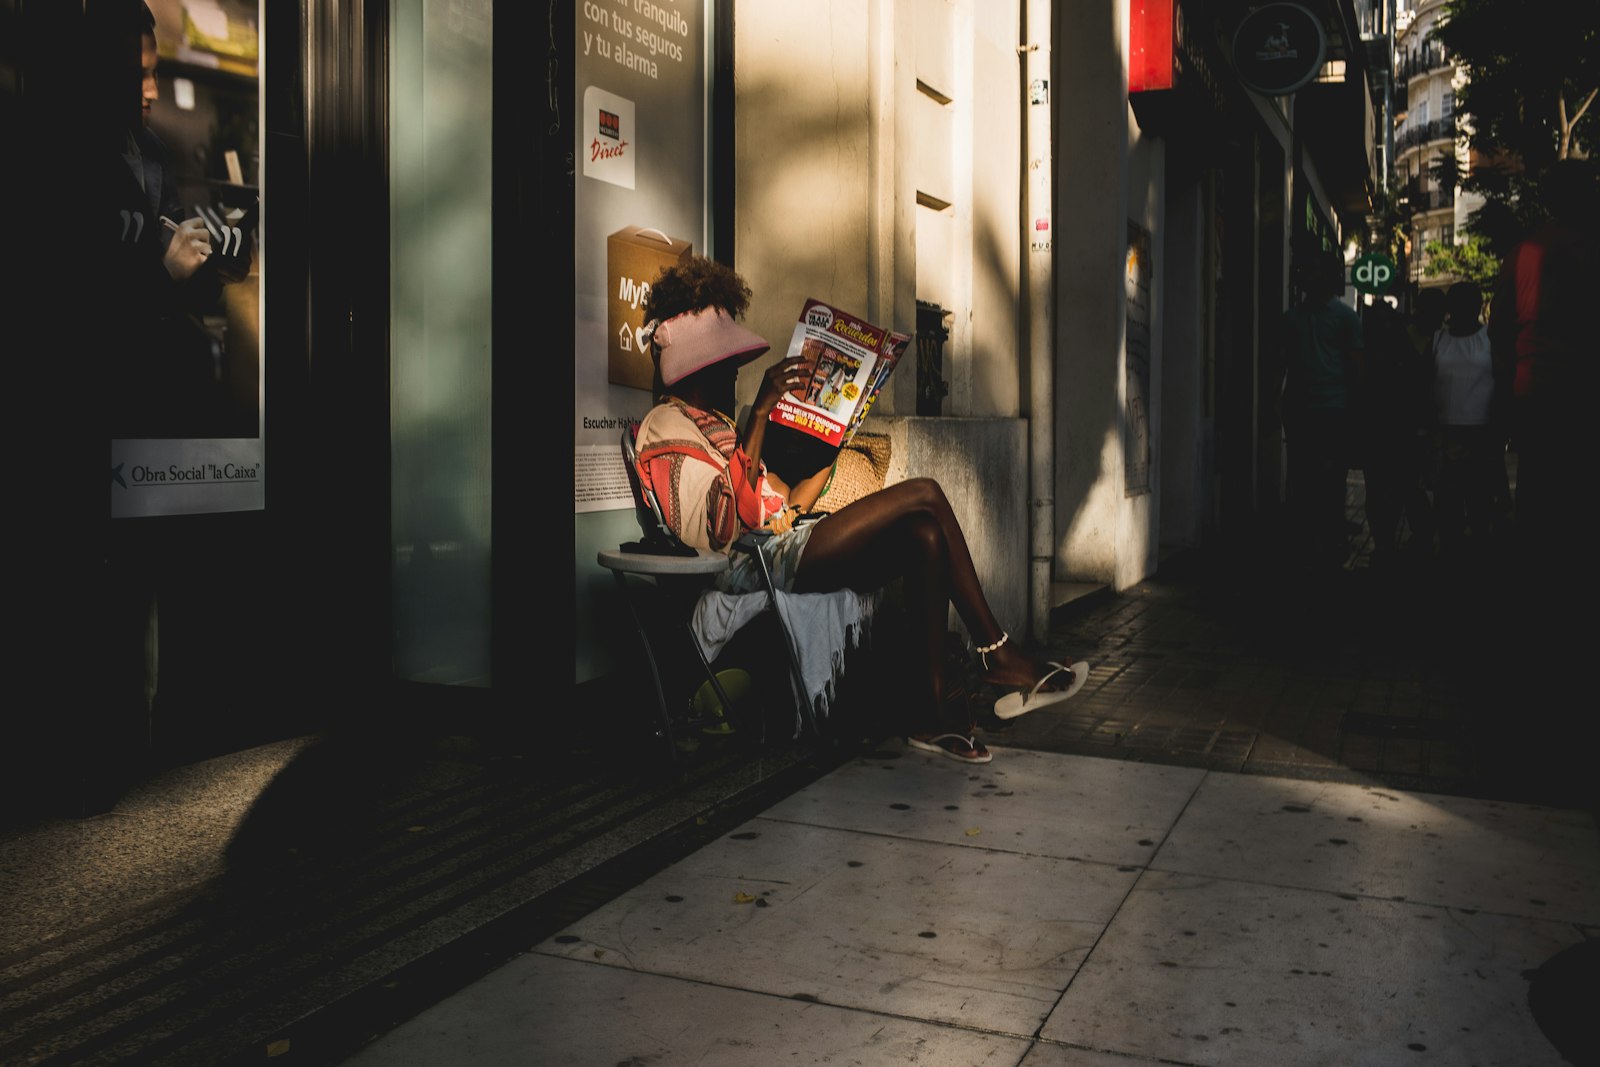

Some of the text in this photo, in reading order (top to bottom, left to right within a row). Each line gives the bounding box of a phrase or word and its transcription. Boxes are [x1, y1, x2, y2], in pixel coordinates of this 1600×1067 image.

[583, 0, 683, 62] con tus seguros
[633, 0, 688, 37] tranquilo
[583, 30, 658, 80] y tu alarma
[590, 137, 629, 163] Direct
[1356, 260, 1390, 287] dp
[619, 276, 651, 310] MyB
[833, 319, 878, 347] Recuerdos
[583, 416, 617, 429] Escuchar
[776, 402, 793, 412] CADA
[815, 415, 841, 433] QUIOSCO
[781, 411, 795, 422] POR
[131, 463, 260, 482] Obra Social "la Caixa"
